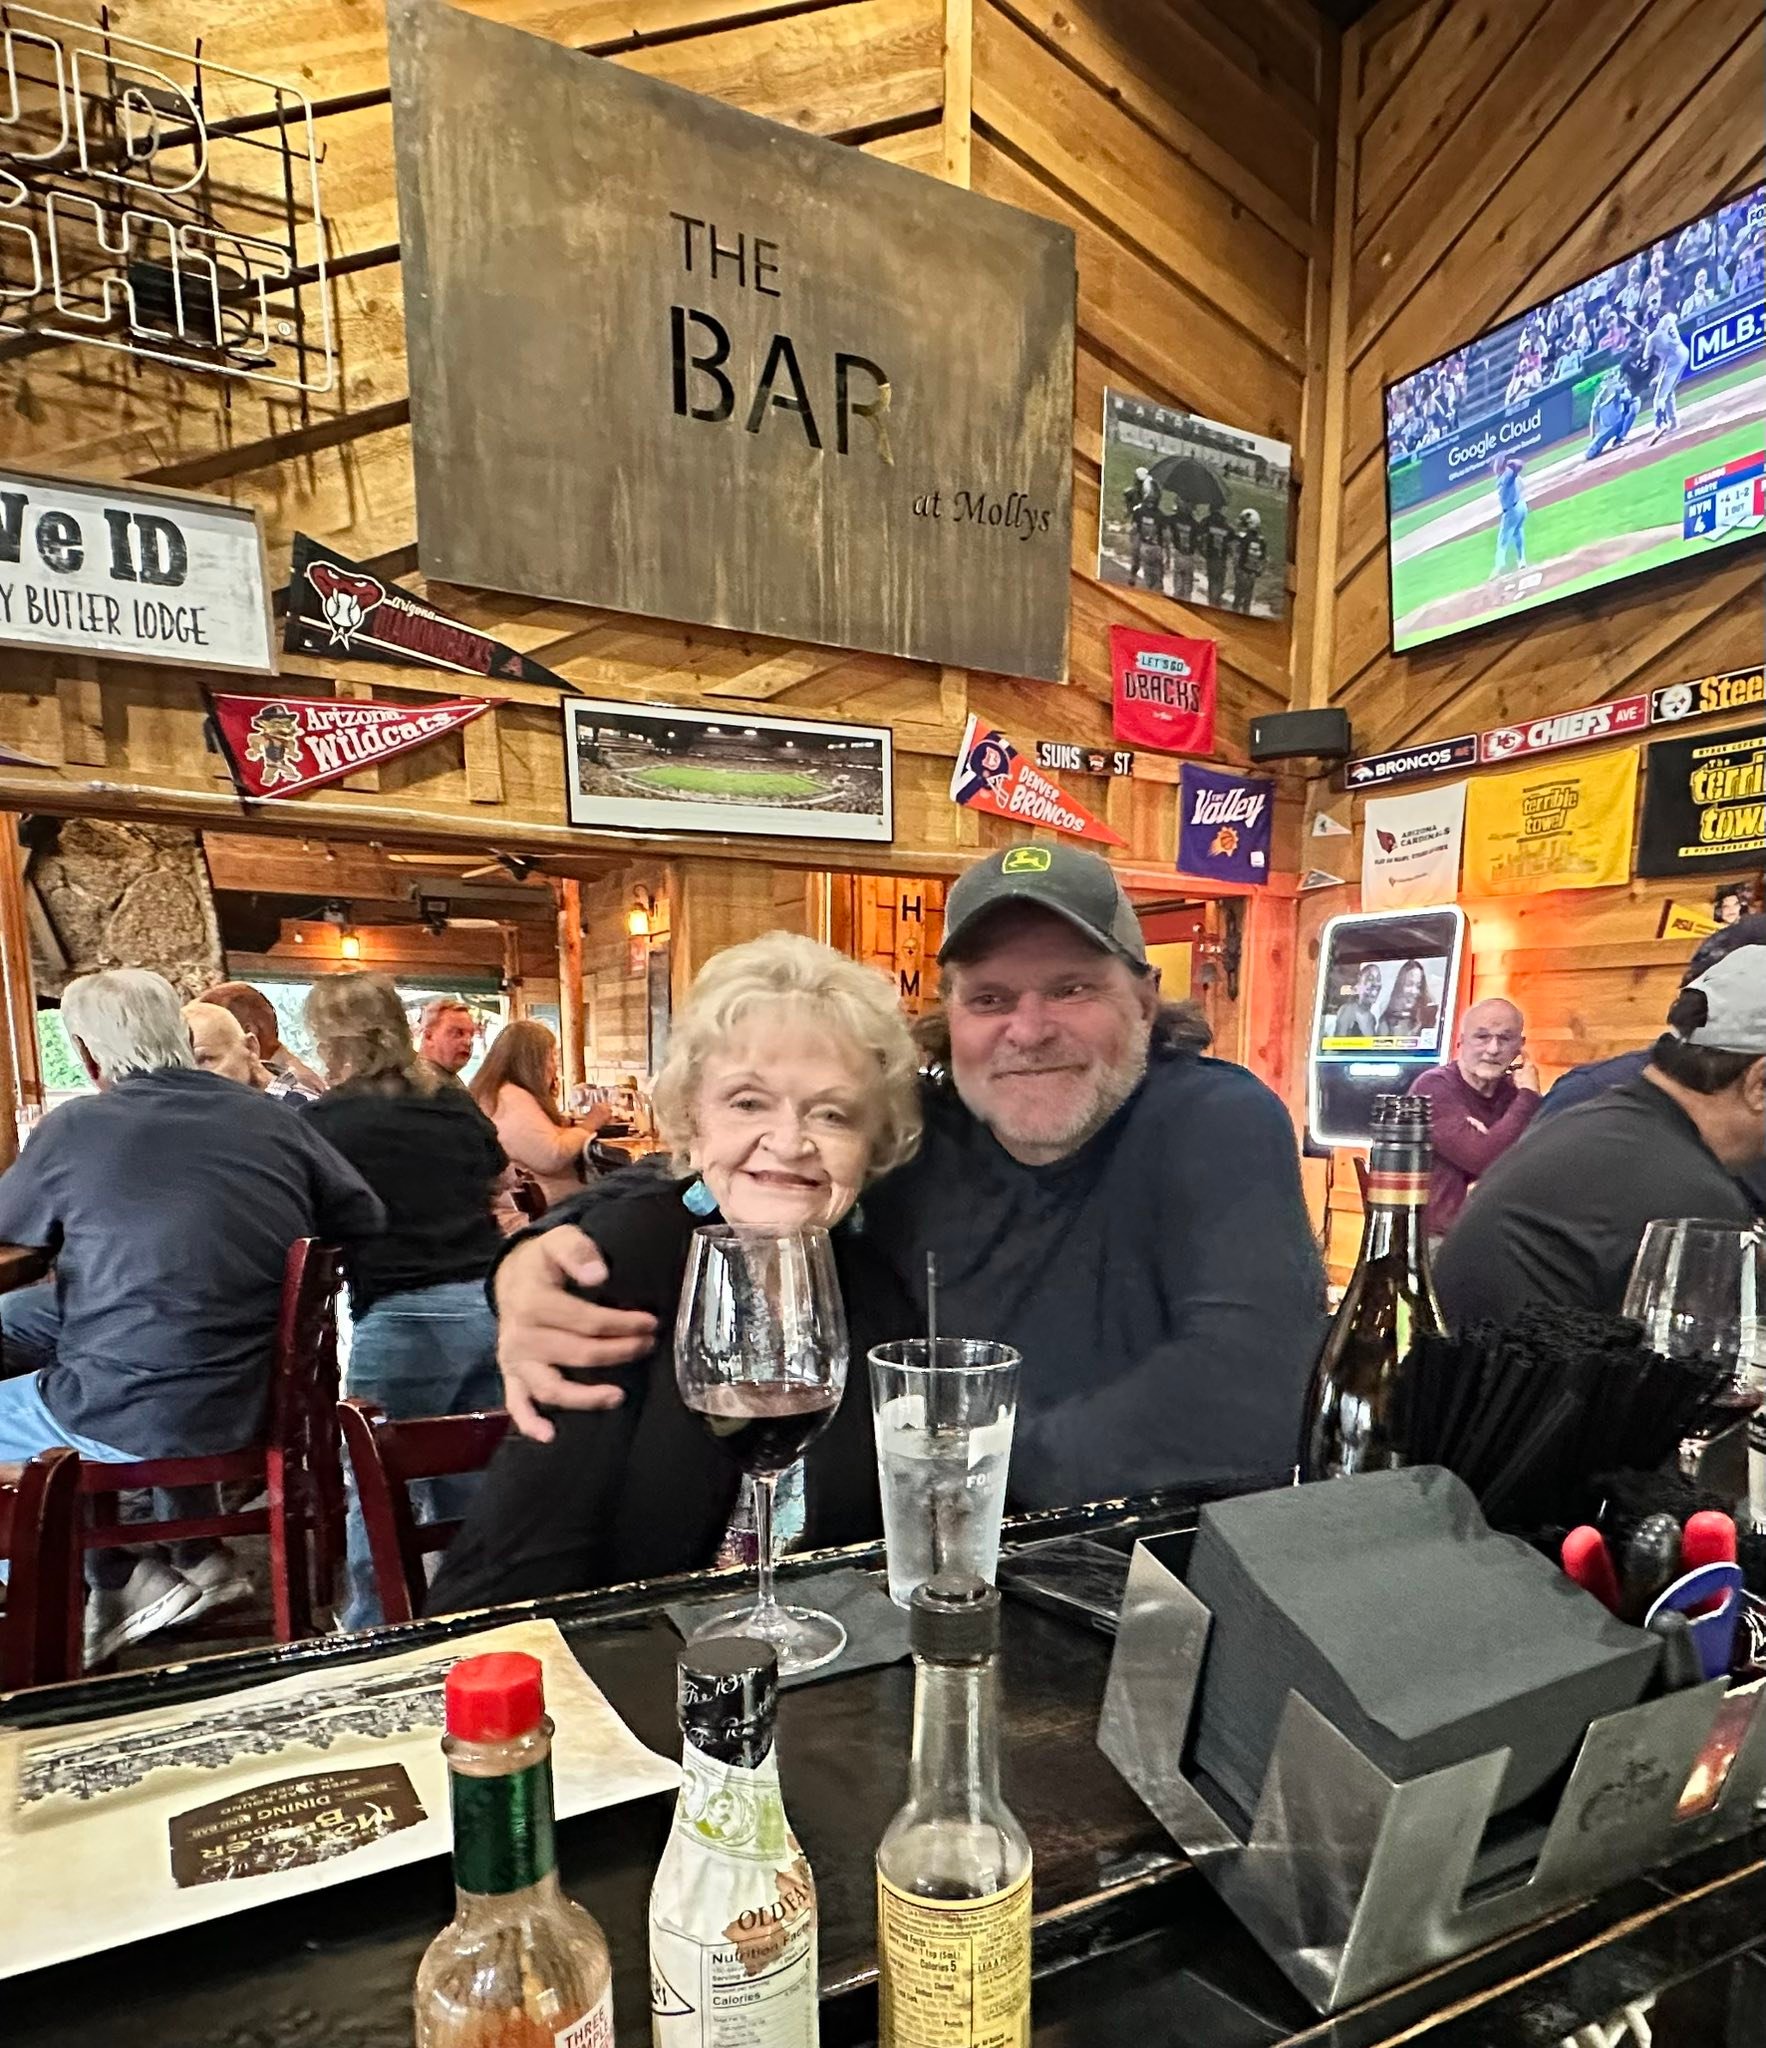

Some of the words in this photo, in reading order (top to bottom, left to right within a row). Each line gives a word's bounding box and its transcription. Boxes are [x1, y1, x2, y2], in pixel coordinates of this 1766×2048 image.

[670, 211, 781, 298] THE
[670, 305, 895, 466] BAR
[1448, 432, 1497, 466] Google
[1500, 408, 1541, 442] Cloud
[913, 491, 940, 518] at
[953, 491, 1051, 541] Mollys
[104, 508, 188, 587] ID
[26, 584, 121, 636] BUTLER
[134, 599, 209, 645] LODGE
[1170, 661, 1184, 672] GO
[305, 707, 400, 731] Arizona
[1527, 706, 1613, 747] CHIEFS
[1615, 707, 1638, 723] AVE
[304, 712, 454, 773] Wildcats
[1042, 743, 1080, 770] SUNS
[1375, 749, 1451, 777] BRONCOS
[1019, 765, 1060, 802] DENVER
[1523, 788, 1578, 815] terrible
[1009, 784, 1085, 832] BRONCOS
[1191, 788, 1266, 828] Valley
[1526, 808, 1567, 834] towel
[257, 1795, 331, 1820] DINING
[737, 1901, 785, 1930] OLD
[920, 1959, 949, 1972] Calories
[950, 1960, 957, 1972] 5
[712, 1991, 761, 2006] Calories
